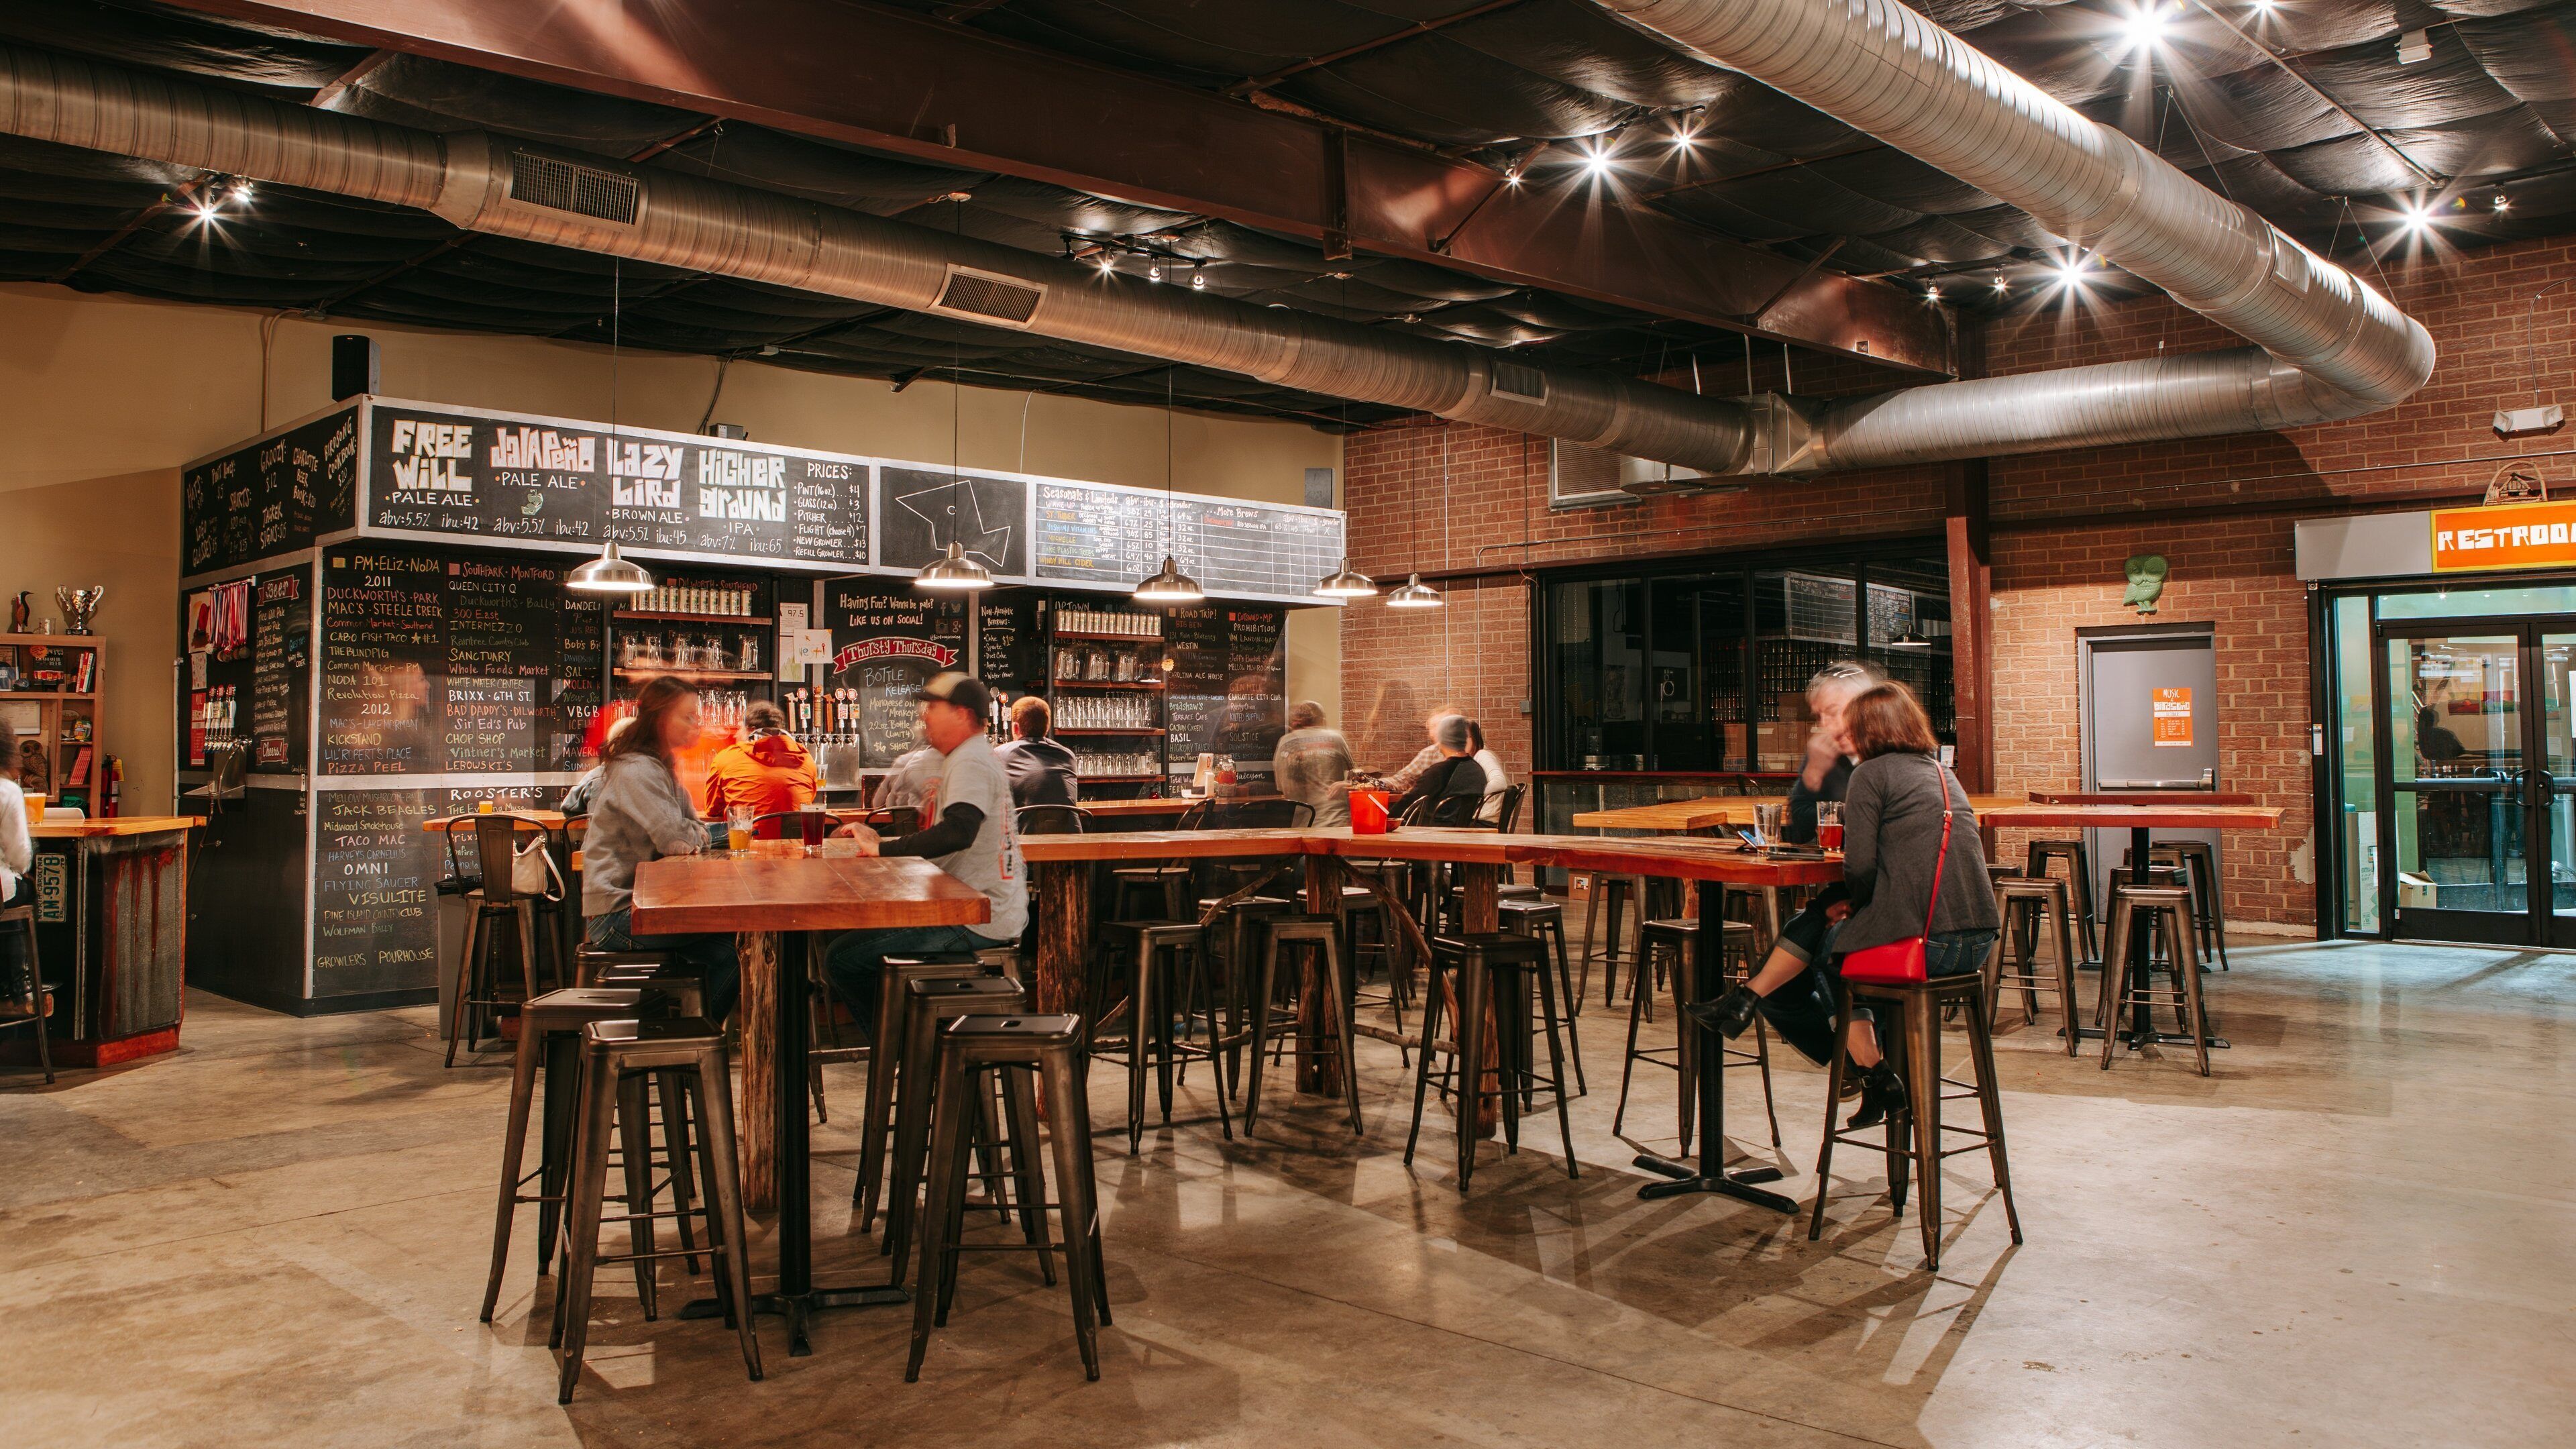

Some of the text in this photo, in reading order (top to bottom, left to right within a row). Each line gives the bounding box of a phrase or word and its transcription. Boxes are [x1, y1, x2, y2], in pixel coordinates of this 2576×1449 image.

[392, 419, 472, 458] FREE
[808, 462, 851, 479] PRICES:
[297, 468, 308, 488] BEER
[502, 472, 578, 489] PALE ALE
[849, 484, 859, 498] $4
[1043, 486, 1083, 501] Seasonals
[392, 491, 472, 506] PALE ALE
[849, 499, 859, 510] $3
[612, 509, 682, 525] BROWN ALE
[798, 510, 864, 523] PITCHER $12
[1236, 508, 1258, 518] Brews
[441, 513, 479, 531] ibu:42
[556, 519, 588, 536] ibu:42
[729, 523, 753, 535] IPA
[799, 524, 824, 535] FLIGHT
[655, 528, 686, 545] ibu:45
[796, 536, 866, 548] NEW $13
[2437, 522, 2576, 551] RESTROO
[750, 536, 782, 553] ibu:65
[796, 547, 866, 559] REFILL $10
[1058, 557, 1094, 568] HILL CIDER
[511, 566, 555, 581] MONTFORD
[365, 576, 391, 586] 2011
[449, 580, 517, 594] QUEEN CITY Q
[327, 587, 406, 602] DUCKWORTH'S
[840, 594, 934, 611] Having Fun? Wanna be pals?
[328, 602, 442, 618] MAC'S STEELE CREEK
[451, 608, 499, 621] 300 East
[1180, 608, 1217, 620] ROAD TRIP!
[849, 613, 923, 627] LIKE US ON SOCIAL!
[1189, 621, 1202, 629] BEN
[450, 621, 523, 633] INTERMEZZO
[1234, 623, 1275, 633] PROHIBITION
[330, 633, 408, 643] CABO FISH TACO
[565, 639, 586, 649] Bob's
[847, 639, 938, 660] Thursty Thursday
[1176, 641, 1199, 650] WESTIN
[448, 648, 511, 662] SANCTUARY
[327, 661, 420, 673] Common Market PM
[449, 663, 549, 676] Whole Foods Market
[327, 674, 388, 686] NODA 101
[864, 665, 904, 687] BOTTLE
[1208, 673, 1224, 681] HOUSE
[563, 679, 592, 690] NOLEN
[885, 677, 926, 697] RELEASE!
[327, 688, 419, 700] Revolution Pizza
[449, 690, 531, 702] BRIXX 6TH ST.
[2163, 689, 2180, 698] MUSIC
[361, 703, 391, 714] 2012
[447, 704, 556, 716] BAD DADDY'S DILWORTH
[869, 697, 902, 712] Mongeese
[1169, 702, 1203, 711] Bradshaw's
[889, 709, 919, 720] Monkeys
[454, 718, 527, 731] Sir Ed's Pub
[890, 720, 910, 729] Bottle
[1169, 723, 1186, 732] CAJUN
[327, 733, 382, 745] KICKSTAND
[445, 733, 505, 745] CHOP SHOP
[1170, 733, 1191, 743] BASIL
[1229, 732, 1258, 742] SOLSTICE
[262, 739, 282, 757] Cheers!
[890, 742, 911, 751] SHORT
[450, 747, 546, 759] Vintner's Market
[328, 761, 406, 774] PIZZA PEEL
[445, 760, 513, 771] LEBOWSKI'S
[1169, 775, 1182, 784] Total
[450, 786, 543, 802] ROOSTER'S
[333, 804, 437, 816] JACK BEAGLES
[447, 802, 527, 814] THE Muse
[324, 820, 403, 831] Midwood Smokehouse
[335, 835, 406, 847] TACO MAC
[344, 862, 388, 875] OMNI
[325, 877, 419, 892] FLYING SAUCER
[348, 890, 427, 906] VISULITE
[324, 908, 423, 922] PINE CLUB
[323, 924, 366, 937] WOLFMAN
[317, 948, 435, 969] GROWLERS POURHOUSE
